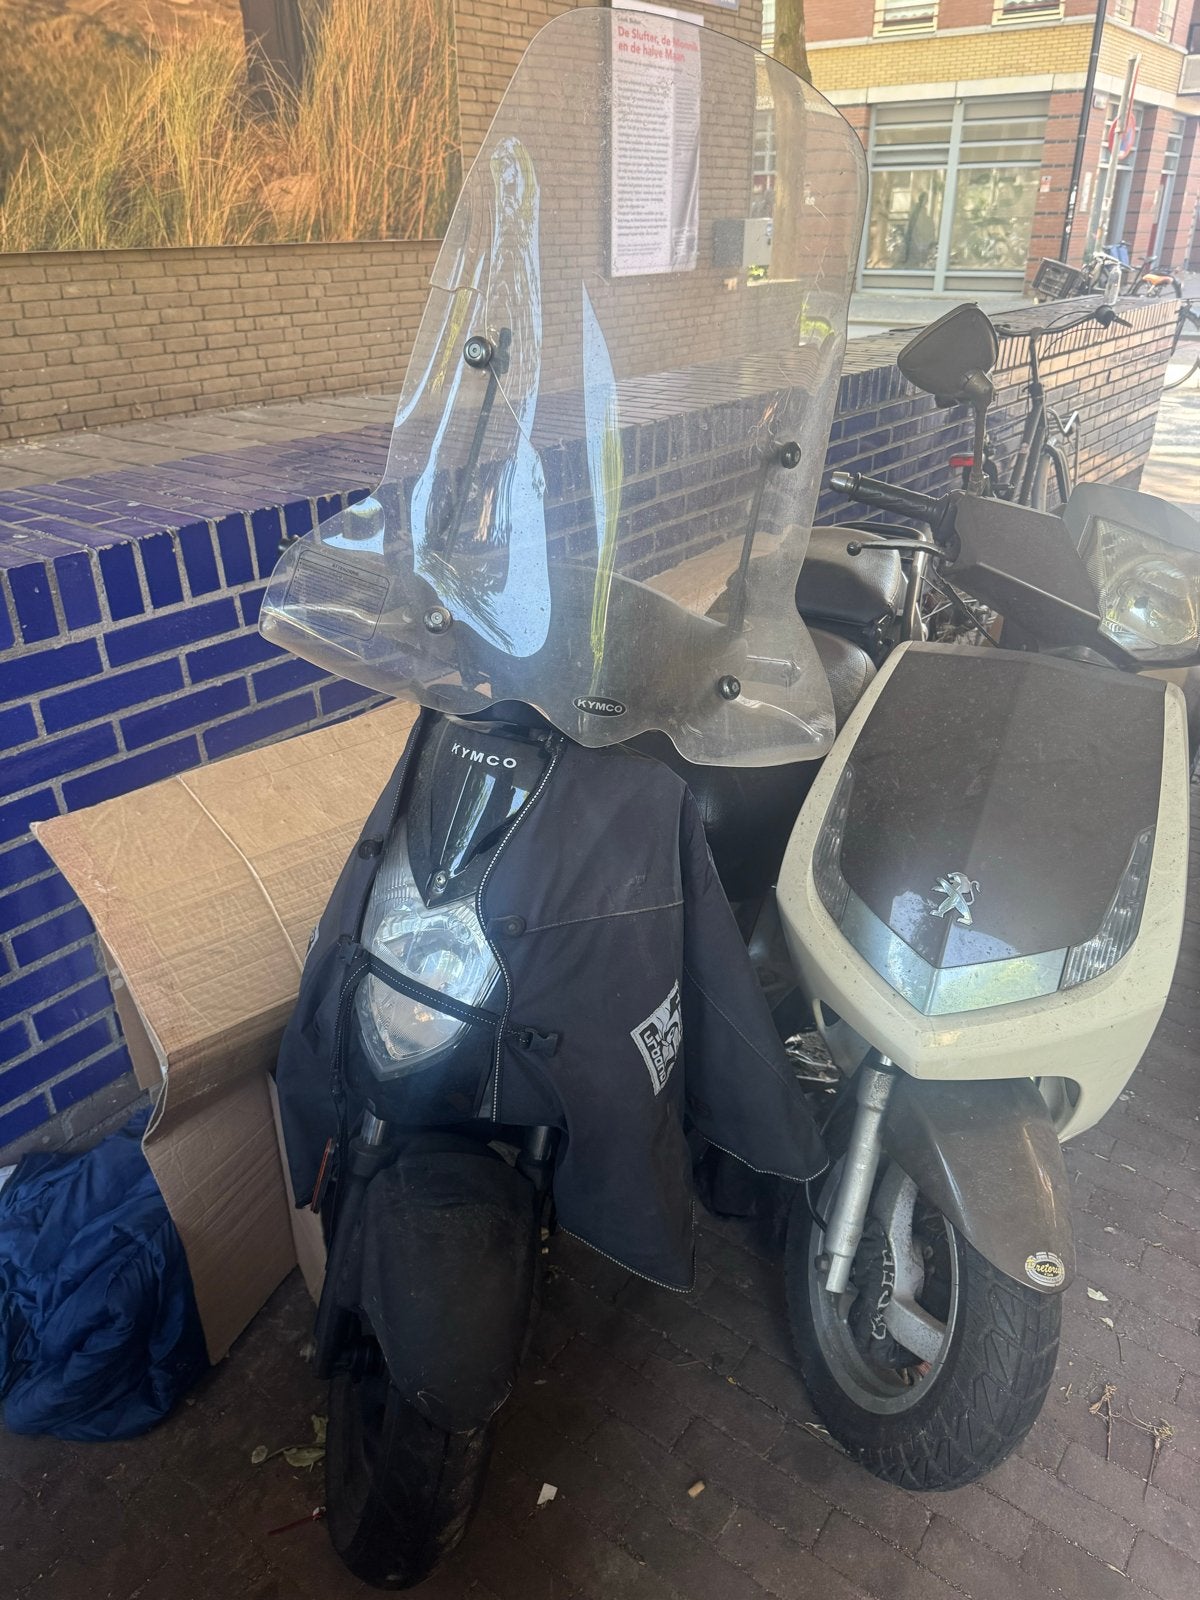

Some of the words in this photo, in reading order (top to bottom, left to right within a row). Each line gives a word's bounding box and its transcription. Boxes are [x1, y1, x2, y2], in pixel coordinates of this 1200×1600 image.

[618, 26, 629, 37] De
[662, 35, 671, 45] de
[618, 43, 628, 52] en
[631, 42, 640, 54] de
[577, 698, 623, 714] KYMCO
[451, 742, 518, 769] KYMCO
